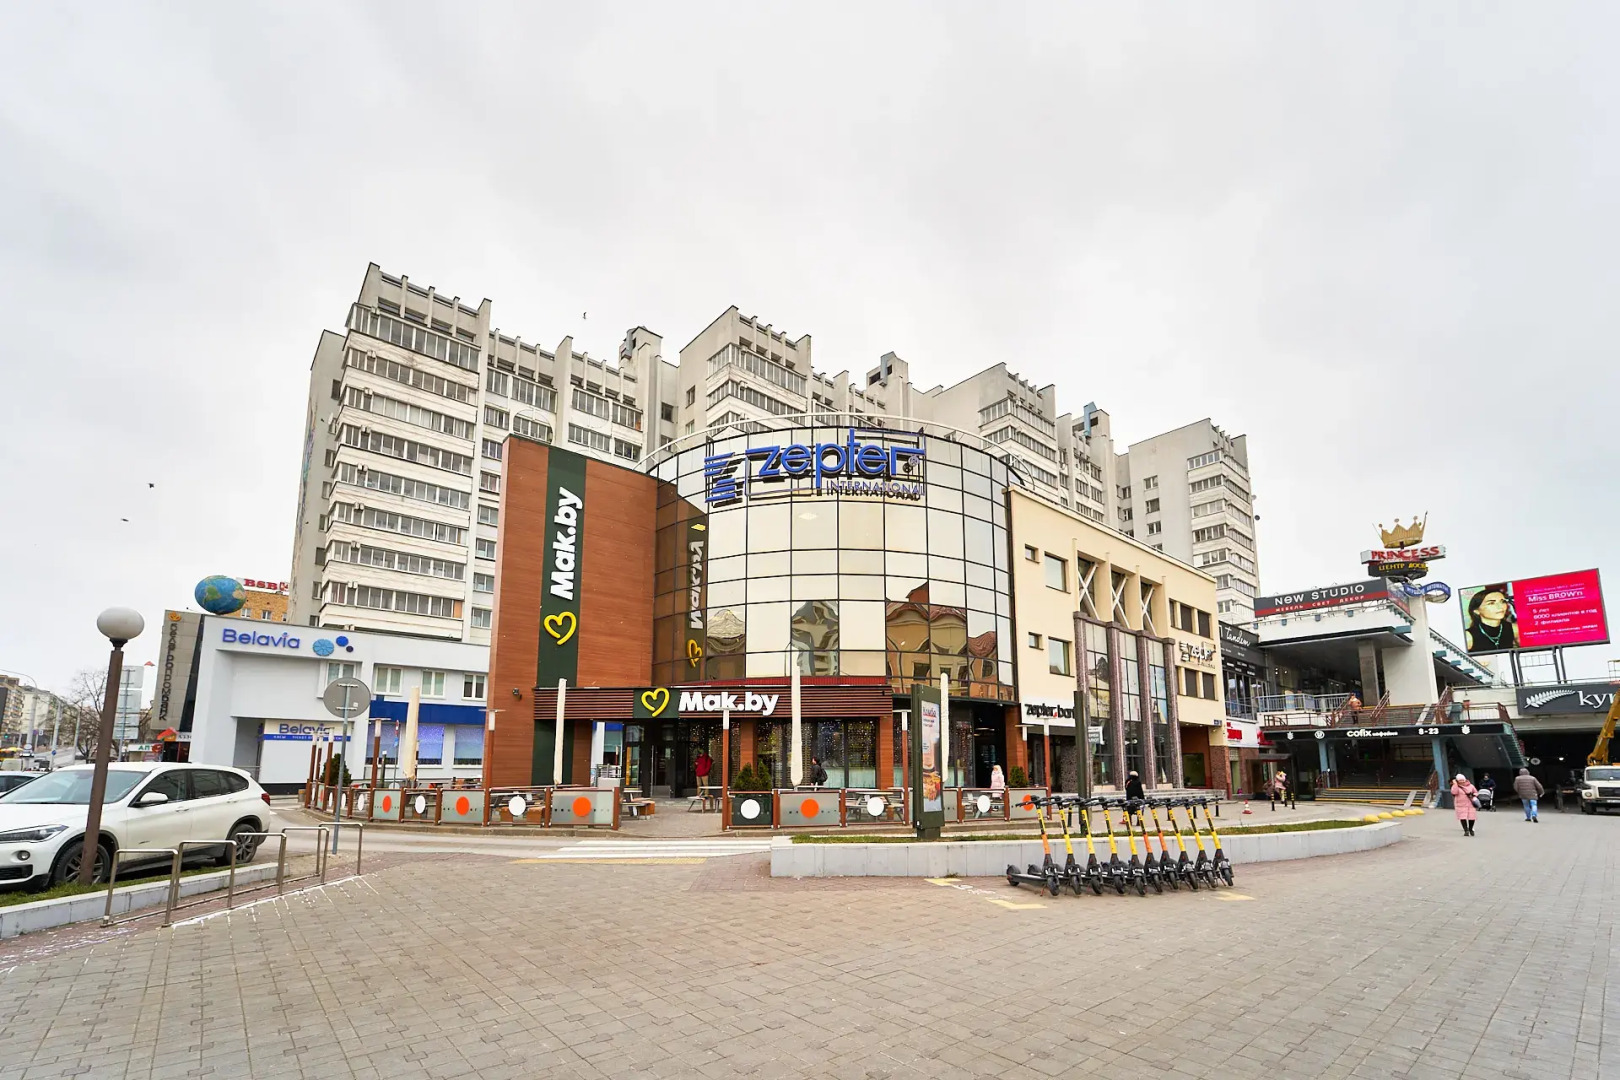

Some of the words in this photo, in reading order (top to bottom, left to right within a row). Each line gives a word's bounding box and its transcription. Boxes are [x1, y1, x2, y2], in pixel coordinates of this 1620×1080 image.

[745, 428, 925, 489] zepter
[826, 480, 925, 497] INTERNATIONAL
[550, 486, 583, 601] Mak.by
[1371, 546, 1440, 560] PRINCESS
[1311, 584, 1365, 600] STUDIO
[1528, 594, 1548, 603] Miss
[1275, 604, 1304, 612] МЕБЕЛЬ
[1339, 595, 1365, 604] ДЕКОР
[222, 628, 300, 649] Belavia
[678, 691, 780, 716] Mak.by
[1346, 728, 1372, 737] cofix
[1418, 727, 1439, 736] 8-23
